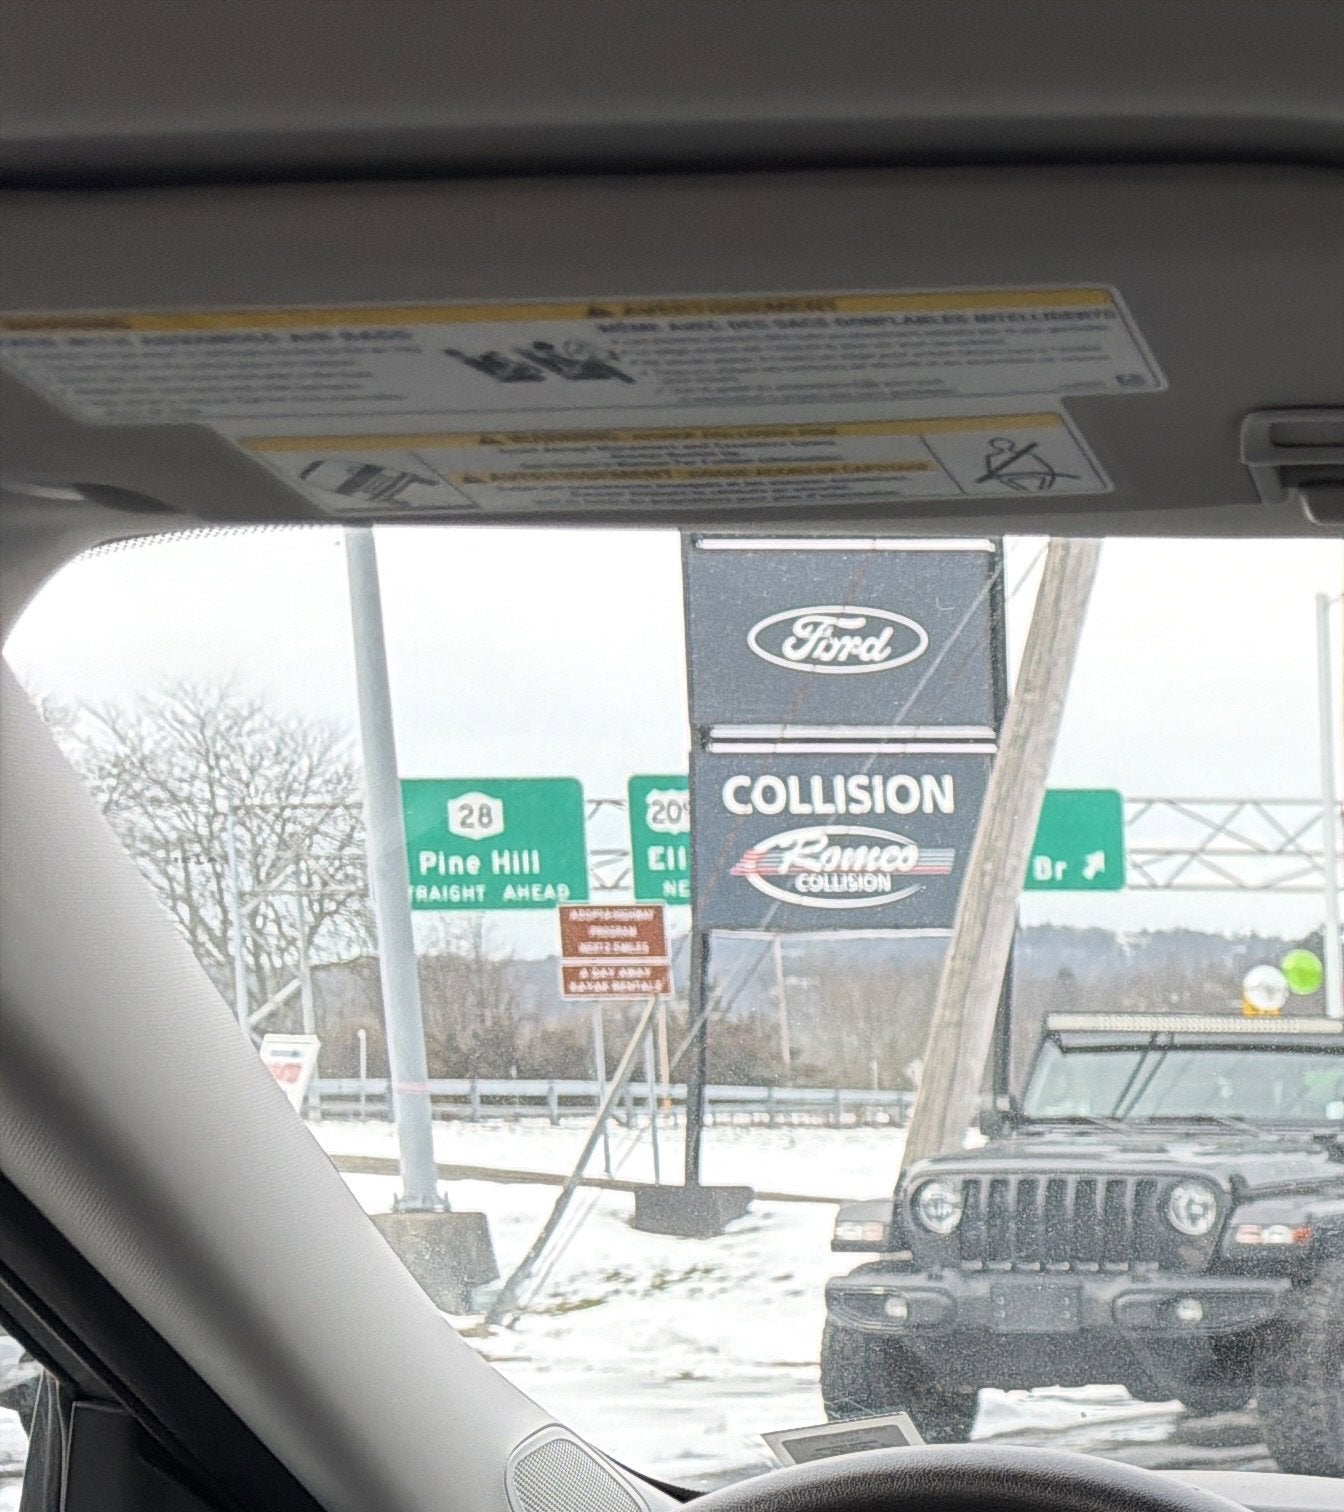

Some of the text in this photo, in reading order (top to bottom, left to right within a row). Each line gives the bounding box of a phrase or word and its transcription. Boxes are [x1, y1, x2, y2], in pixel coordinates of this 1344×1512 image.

[782, 615, 895, 662] Ford
[722, 774, 954, 815] COLLISION
[458, 803, 493, 829] 28
[419, 850, 541, 876] Pine Hill
[1033, 855, 1066, 881] Br
[503, 883, 570, 902] AHEAD
[795, 872, 892, 893] COLLISION
